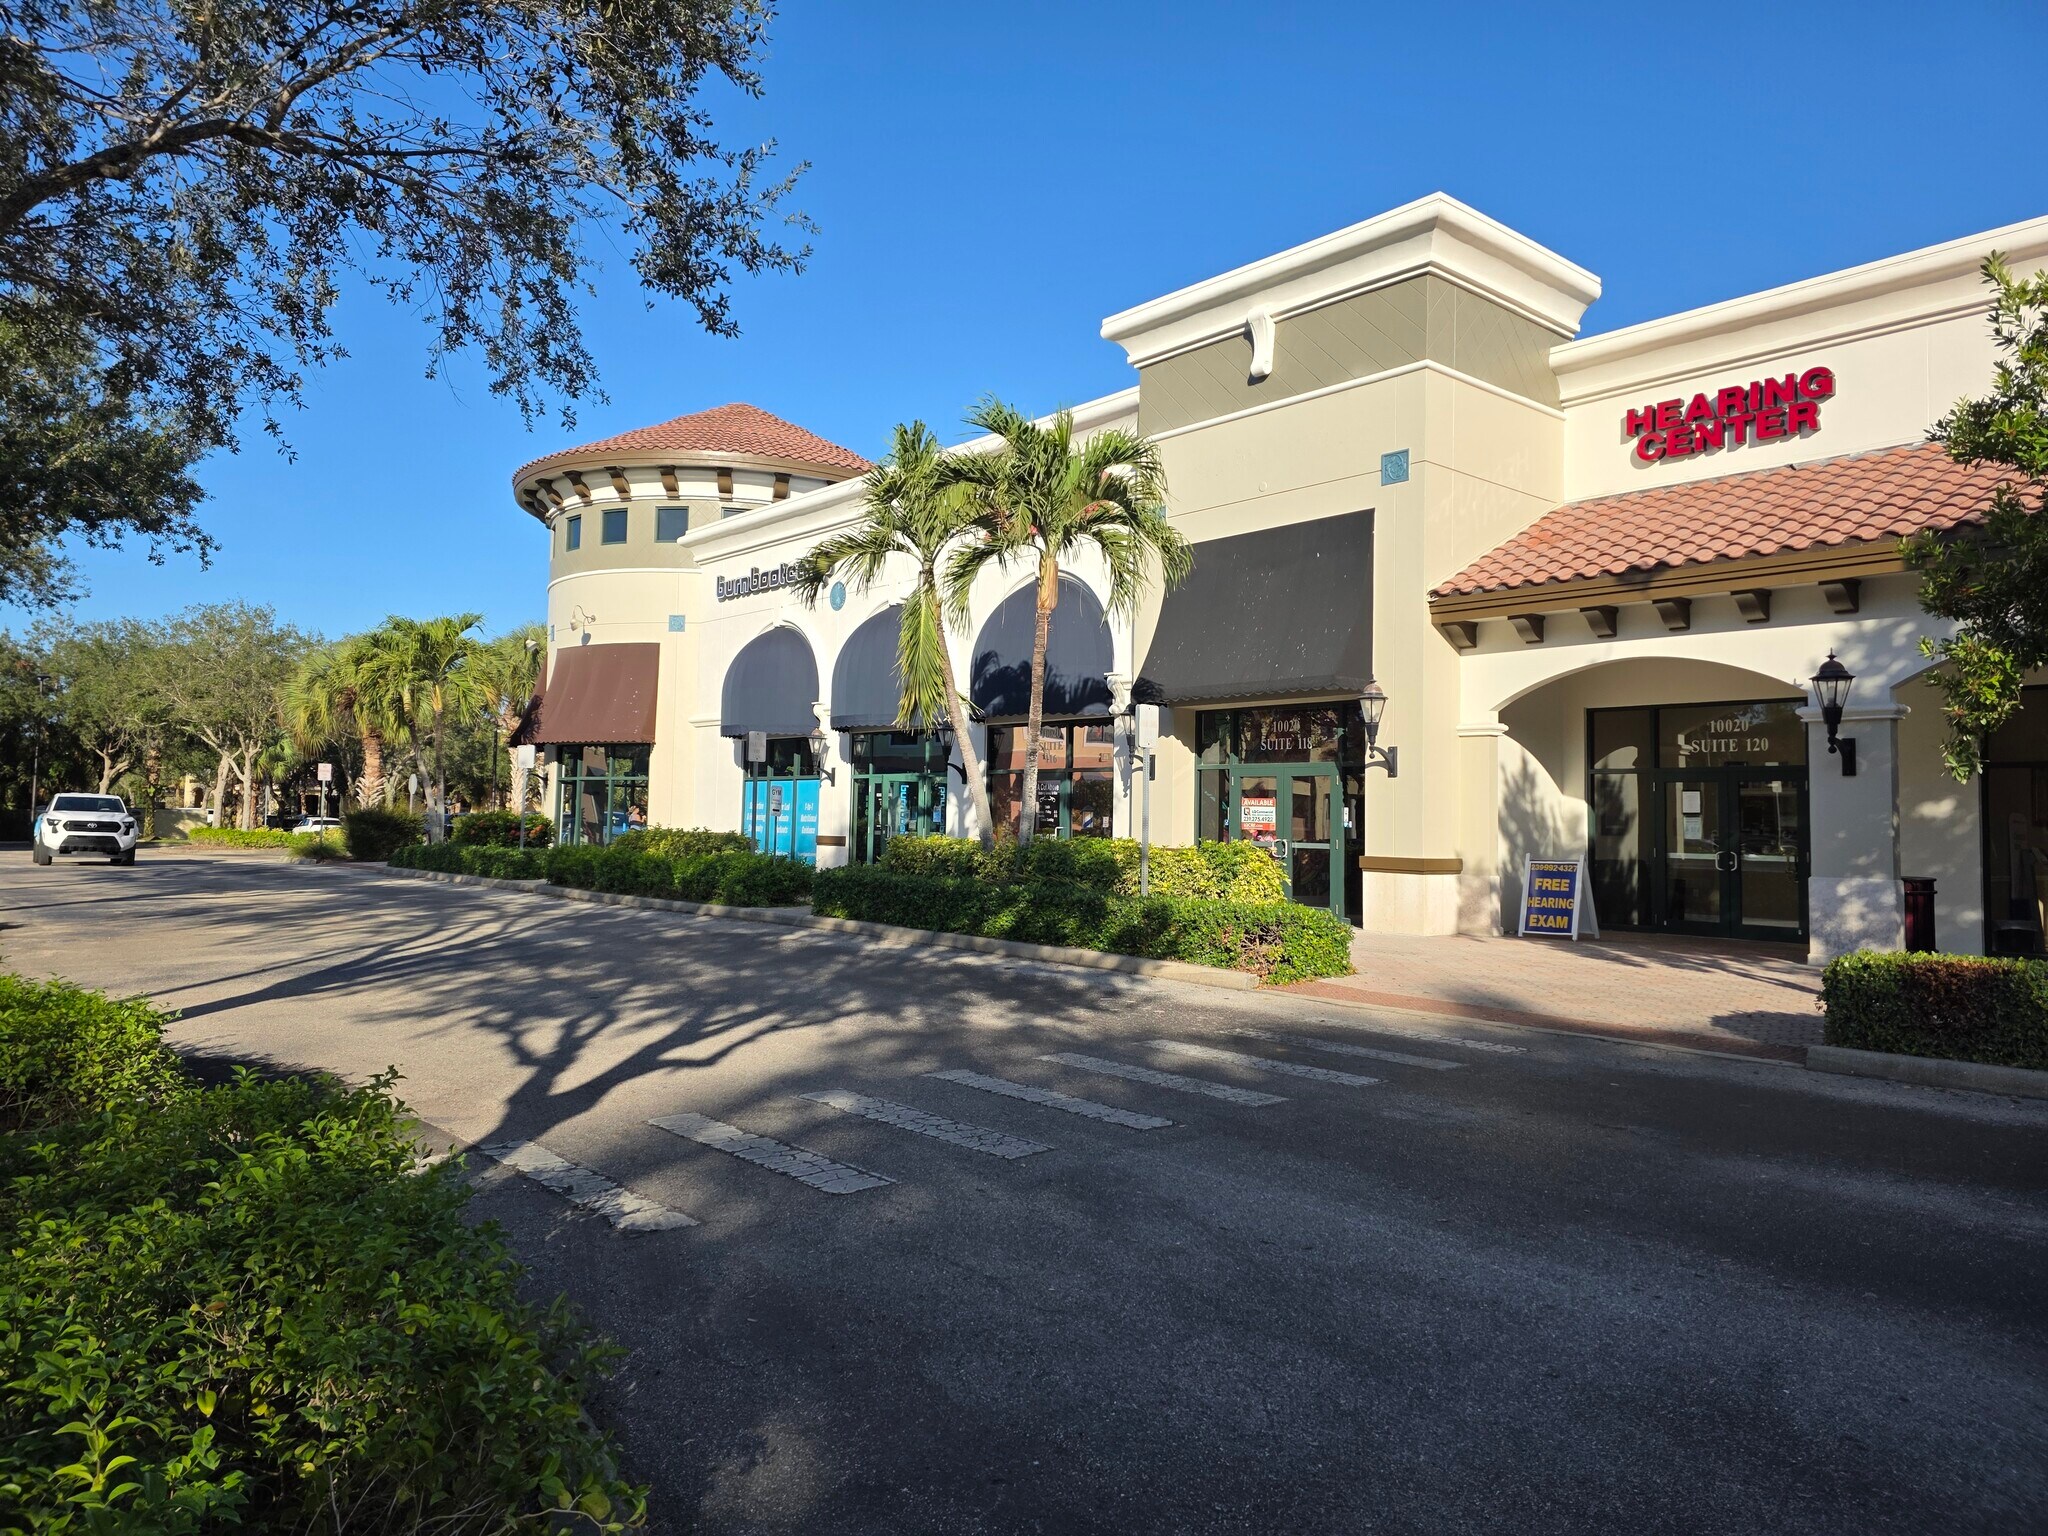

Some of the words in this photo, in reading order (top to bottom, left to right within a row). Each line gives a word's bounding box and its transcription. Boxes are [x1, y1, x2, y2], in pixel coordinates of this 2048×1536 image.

[1626, 366, 1834, 437] HEARING
[1636, 401, 1820, 461] CENTER
[1709, 719, 1749, 733] 10020
[1260, 738, 1293, 751] SUITE
[1297, 737, 1313, 750] 118
[1691, 739, 1739, 753] SUITE
[1746, 738, 1769, 752] 120
[1534, 877, 1570, 892] FREE
[1527, 896, 1574, 910] HEARING
[1528, 914, 1569, 929] EXAM
